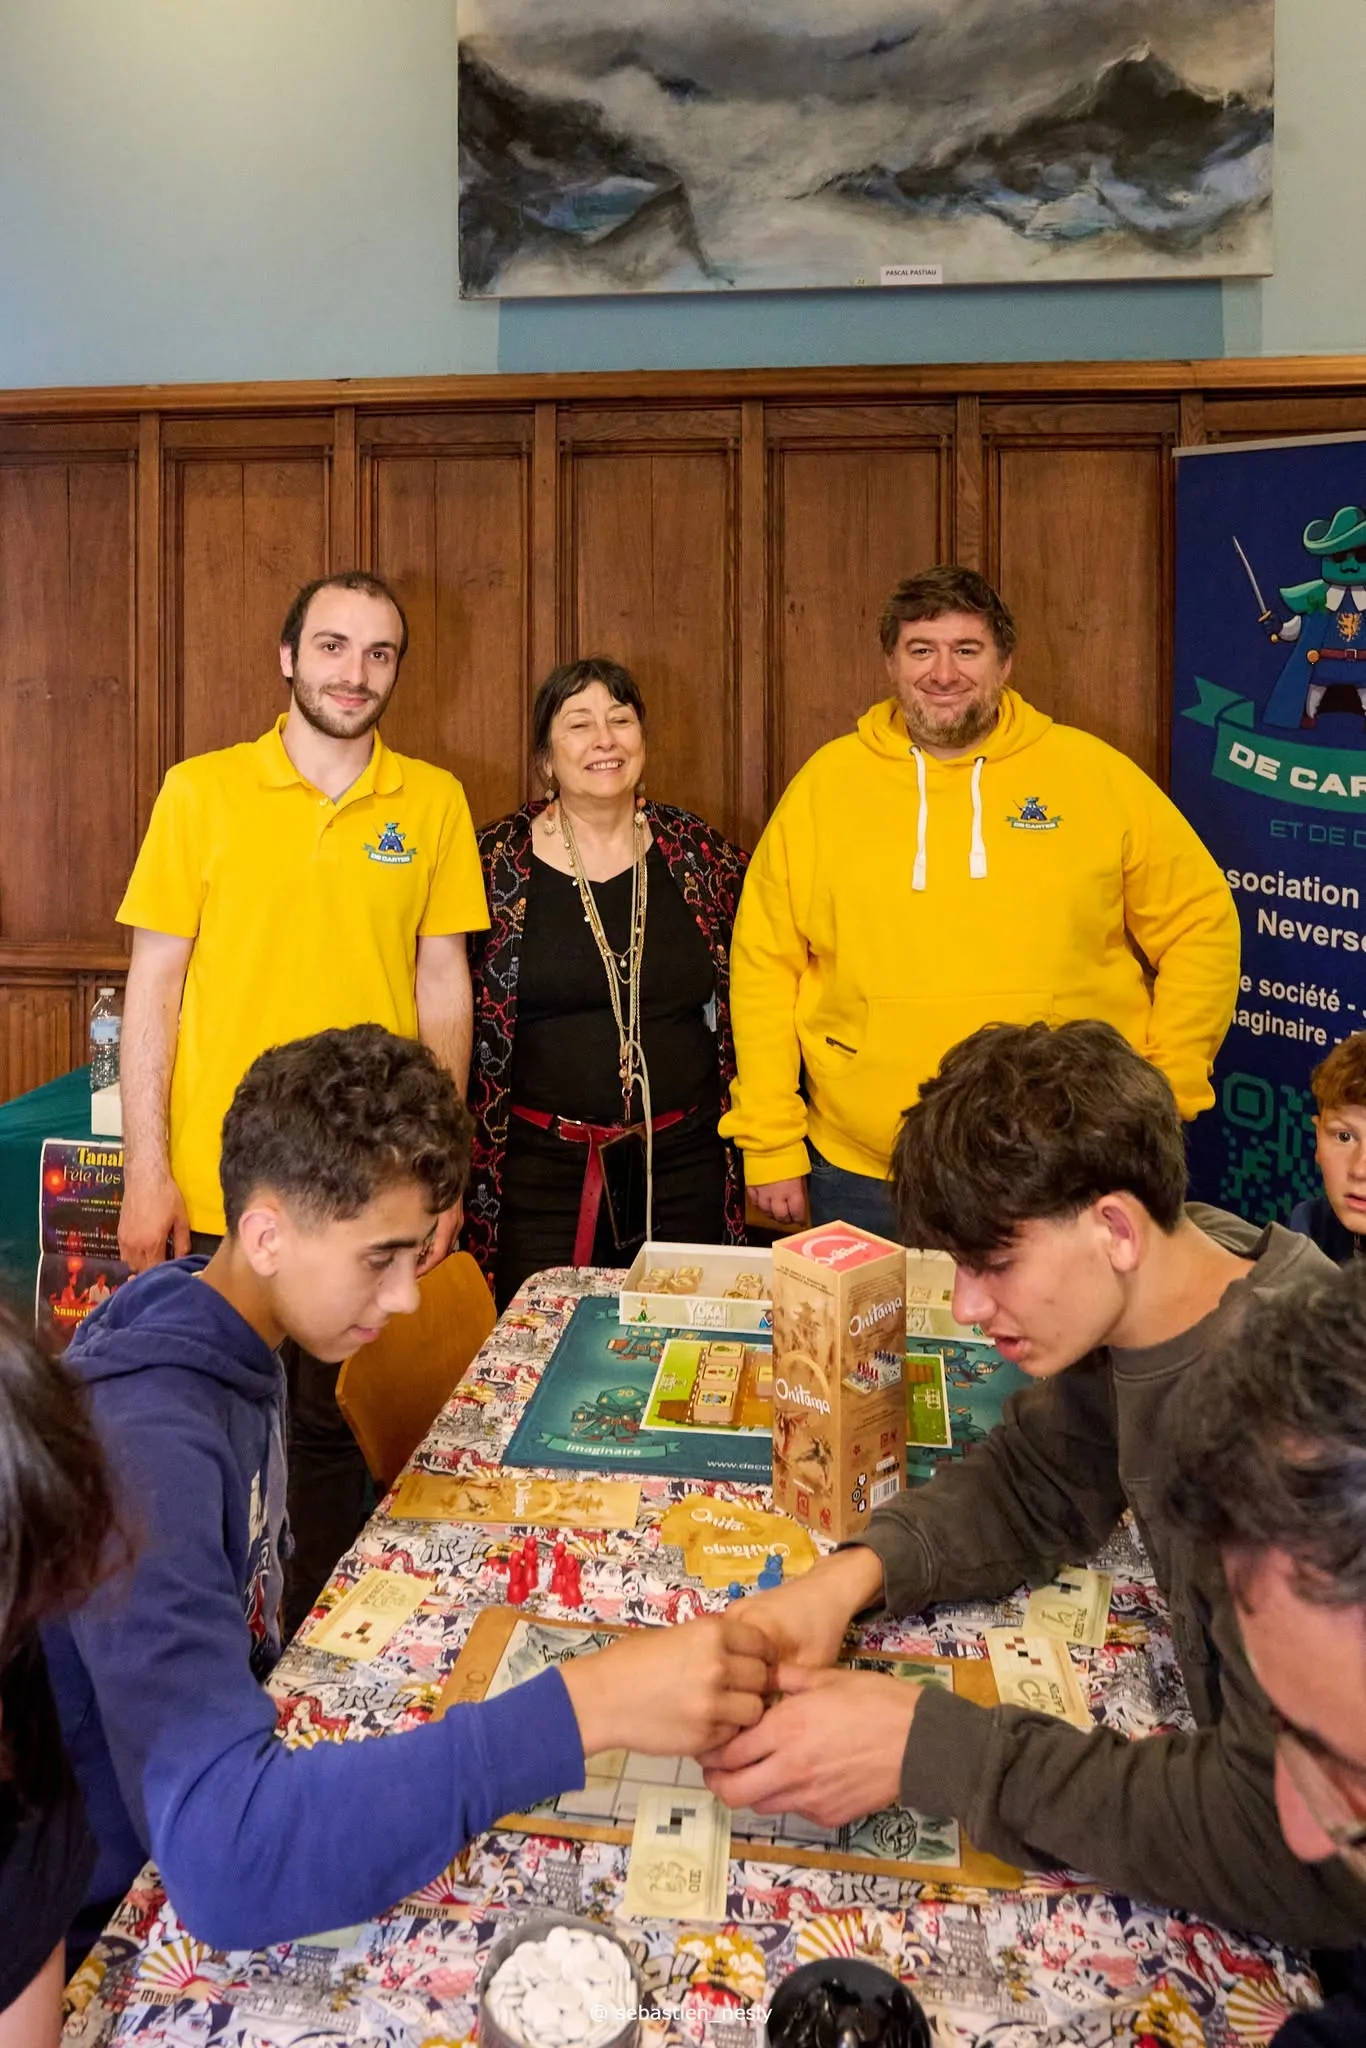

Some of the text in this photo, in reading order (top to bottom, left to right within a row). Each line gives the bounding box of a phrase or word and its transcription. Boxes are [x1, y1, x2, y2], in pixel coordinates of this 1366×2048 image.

[1229, 742, 1280, 781] DE
[1271, 820, 1303, 839] ET
[1310, 824, 1346, 846] DE
[1225, 869, 1359, 909] sociation
[1259, 978, 1340, 1012] société
[1233, 1009, 1328, 1046] aginaire
[96, 1168, 120, 1184] des
[848, 1297, 902, 1336] Onitama
[775, 1377, 831, 1415] Onitama
[688, 1869, 702, 1893] OIE
[403, 1903, 449, 1918] MANGA
